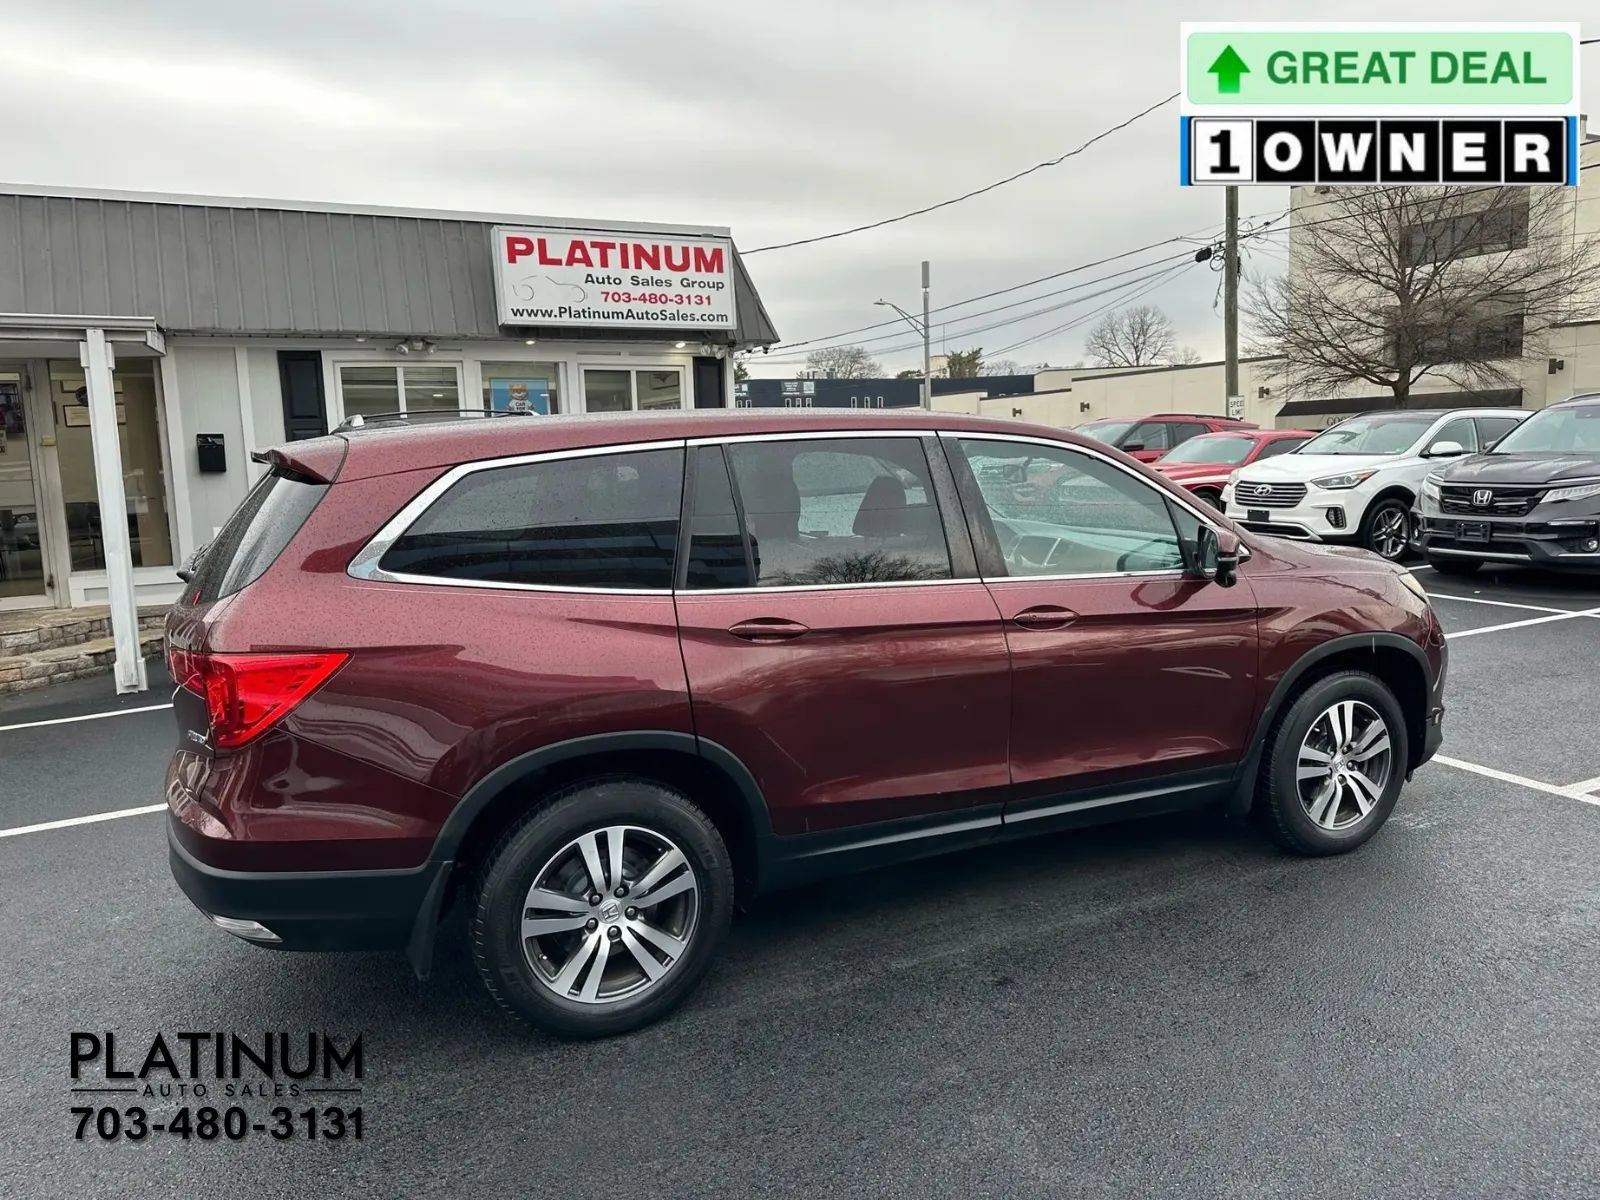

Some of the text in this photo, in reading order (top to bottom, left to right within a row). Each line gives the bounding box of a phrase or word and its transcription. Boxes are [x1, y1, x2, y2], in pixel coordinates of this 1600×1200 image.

[506, 236, 725, 274] PLATINUM
[584, 273, 725, 291] Auto Sales Group
[600, 291, 712, 306] 703-480-3131
[510, 306, 729, 323] www.PlatinumAutoSales.com
